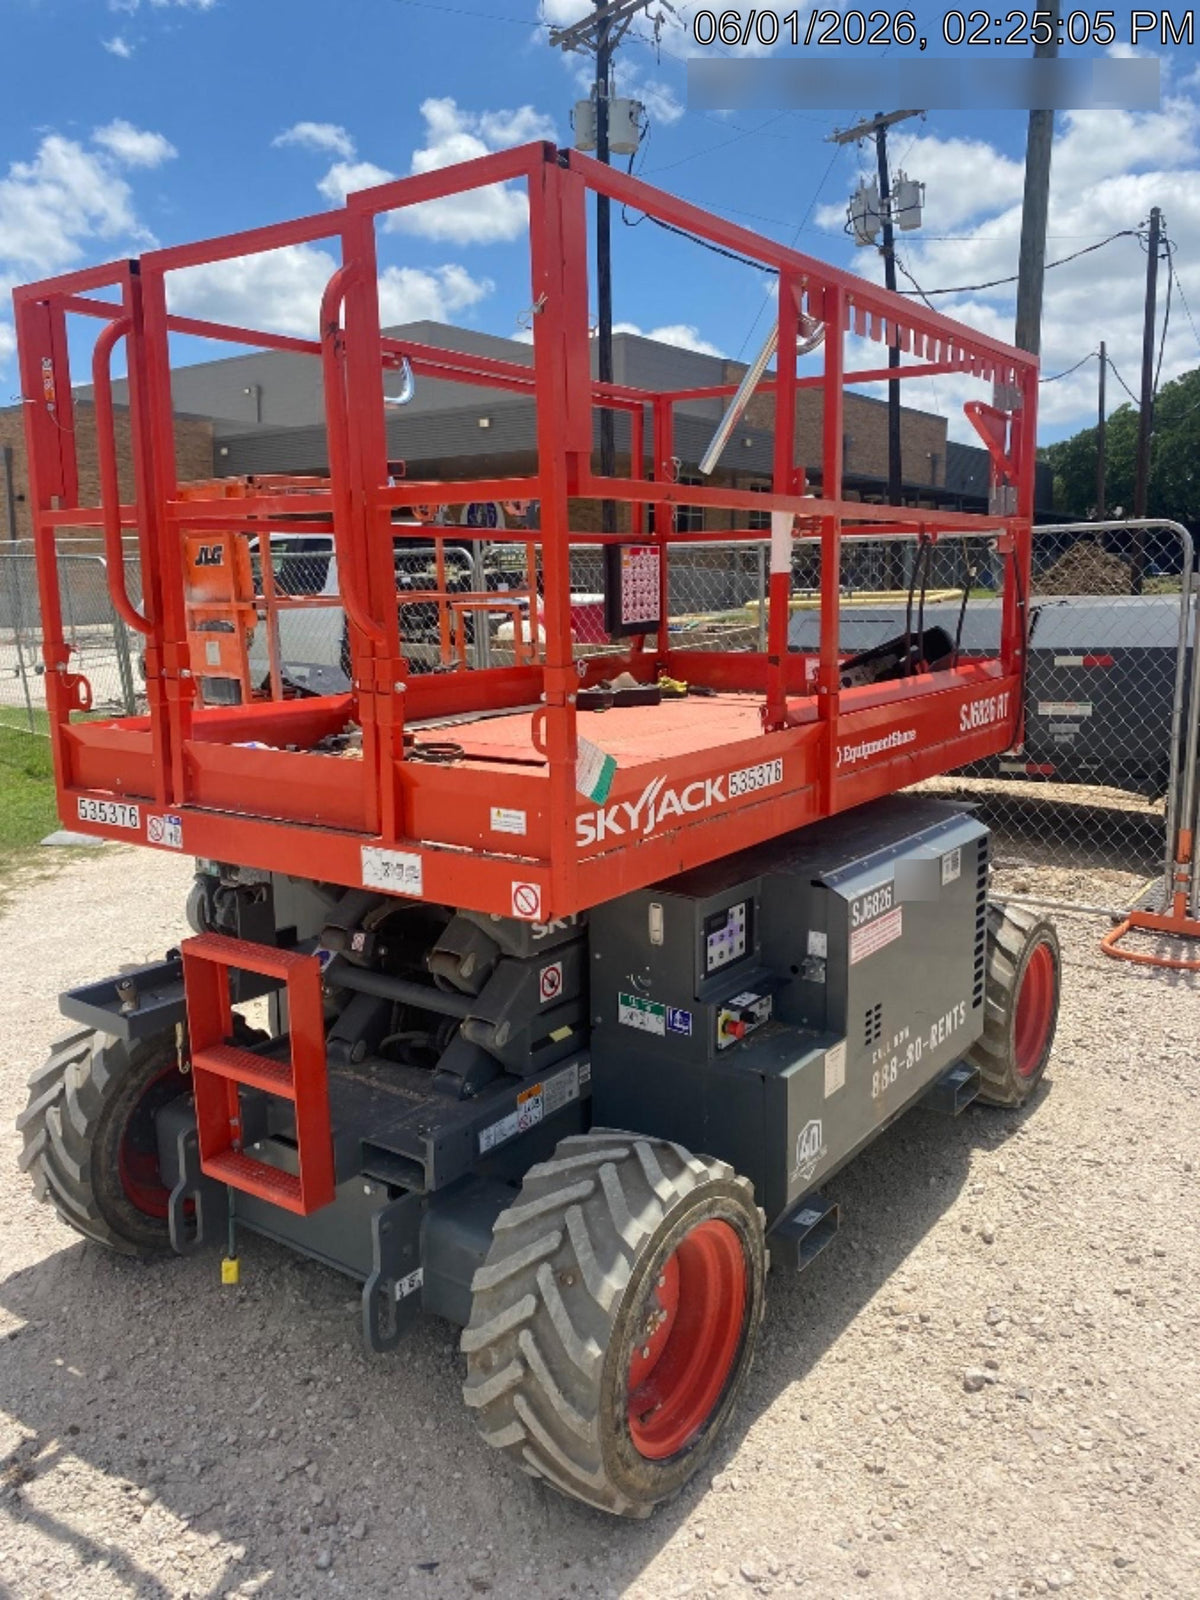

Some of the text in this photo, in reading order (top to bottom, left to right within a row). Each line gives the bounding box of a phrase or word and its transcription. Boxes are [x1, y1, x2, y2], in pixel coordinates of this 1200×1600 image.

[195, 545, 222, 566] JLG
[730, 760, 781, 795] 535376
[79, 799, 138, 828] 535376
[576, 774, 726, 847] SKYJACK
[851, 886, 892, 927] SJ6826
